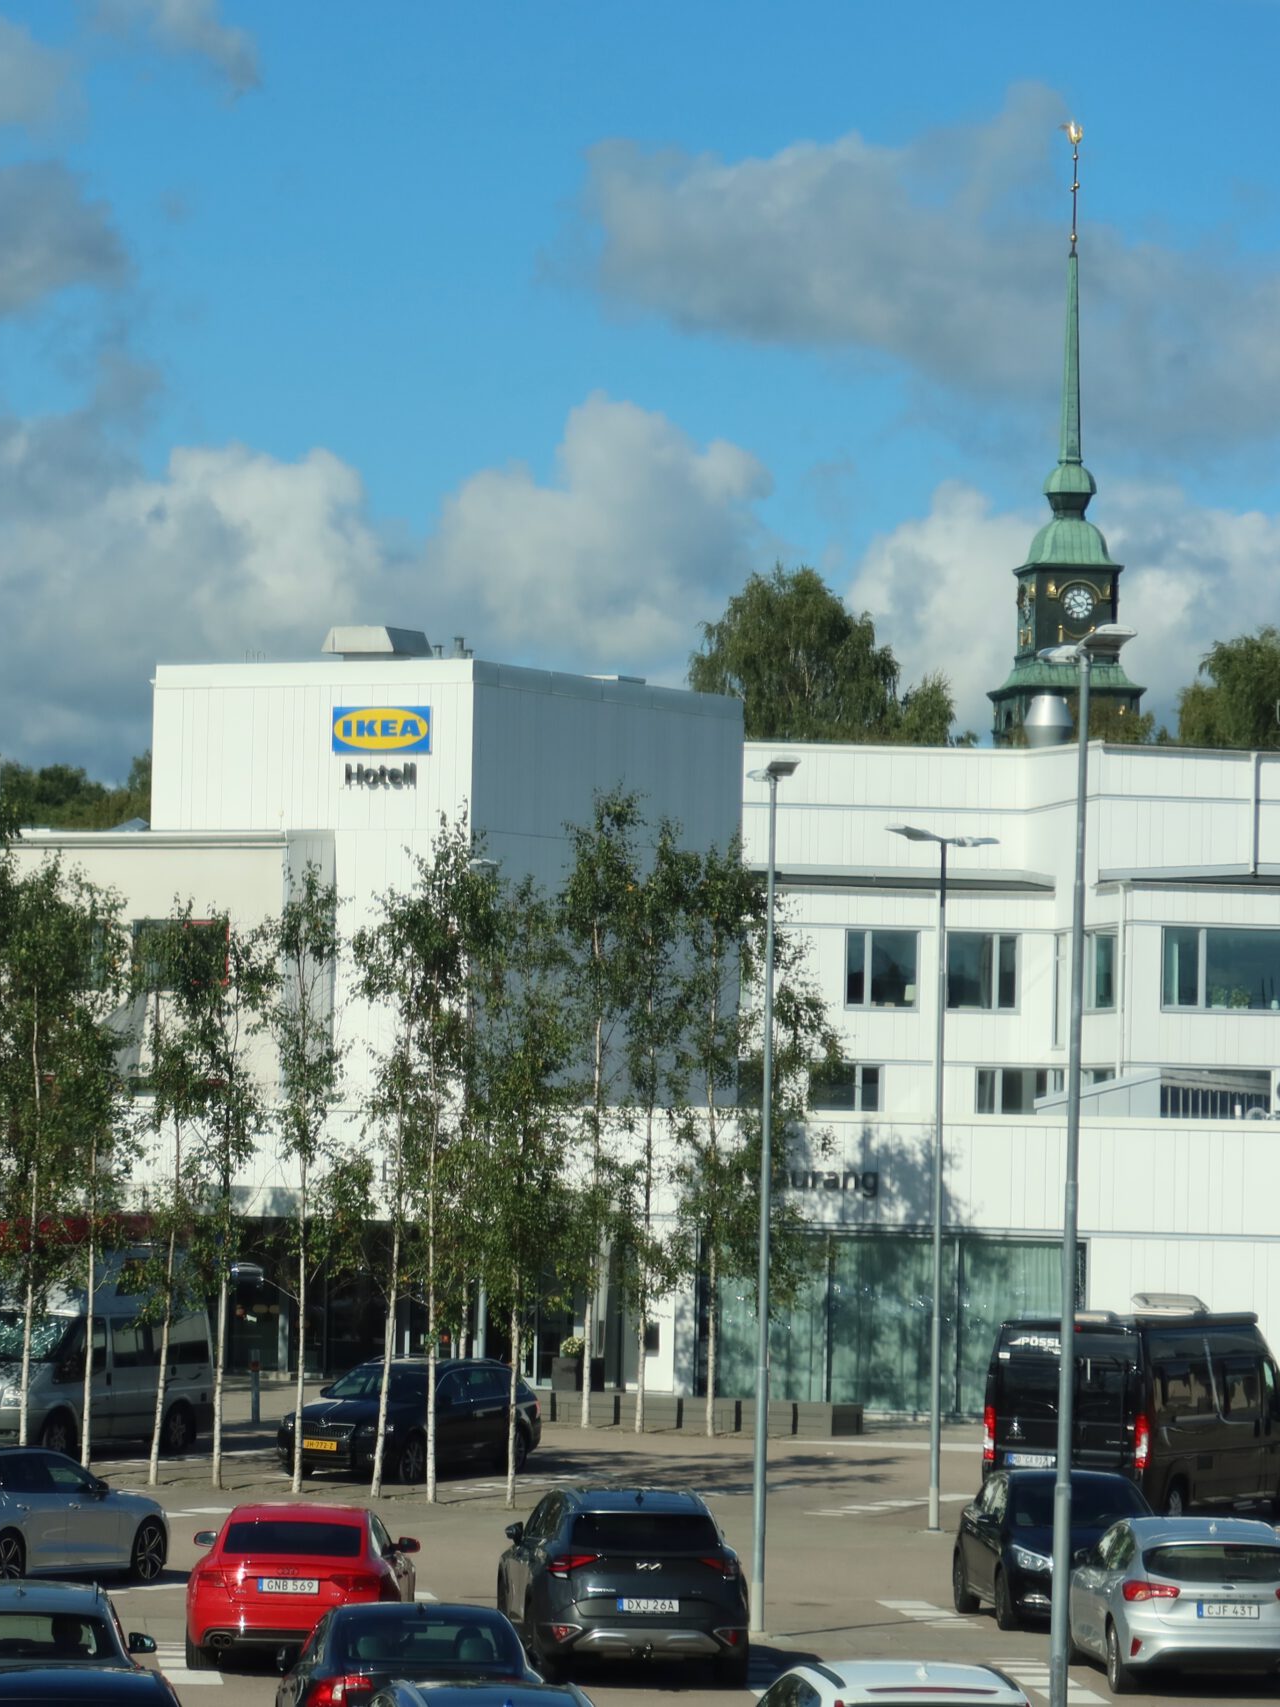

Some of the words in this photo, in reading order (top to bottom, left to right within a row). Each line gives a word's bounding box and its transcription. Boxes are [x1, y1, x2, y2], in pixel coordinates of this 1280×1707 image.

[342, 719, 421, 738] IKEA
[345, 762, 417, 789] Hotell
[267, 1580, 288, 1591] GNB
[292, 1581, 314, 1592] 569
[627, 1599, 649, 1610] DXJ
[653, 1600, 674, 1611] 26A
[1207, 1605, 1228, 1616] CJF
[1232, 1606, 1253, 1617] 43T
